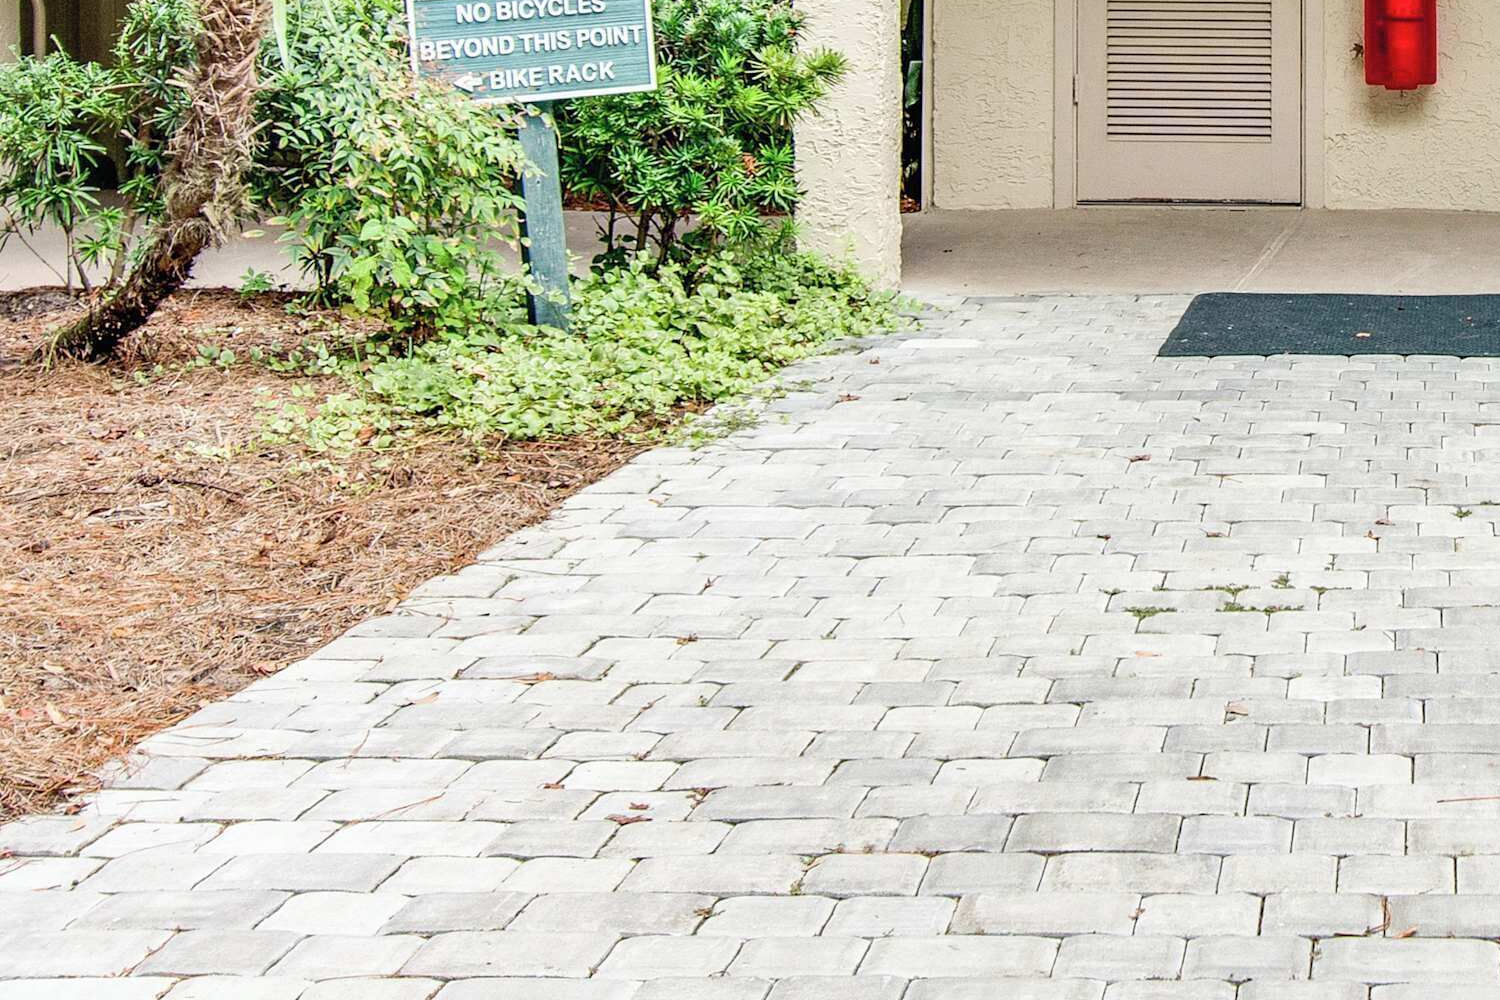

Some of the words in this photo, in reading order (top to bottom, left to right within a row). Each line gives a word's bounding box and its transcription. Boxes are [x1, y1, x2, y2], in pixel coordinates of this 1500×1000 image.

[456, 3, 491, 24] NO
[419, 36, 515, 62] BEYOND
[517, 30, 572, 54] THIS
[577, 24, 643, 49] POINT
[490, 67, 545, 91] BIKE
[548, 61, 616, 85] RACK
